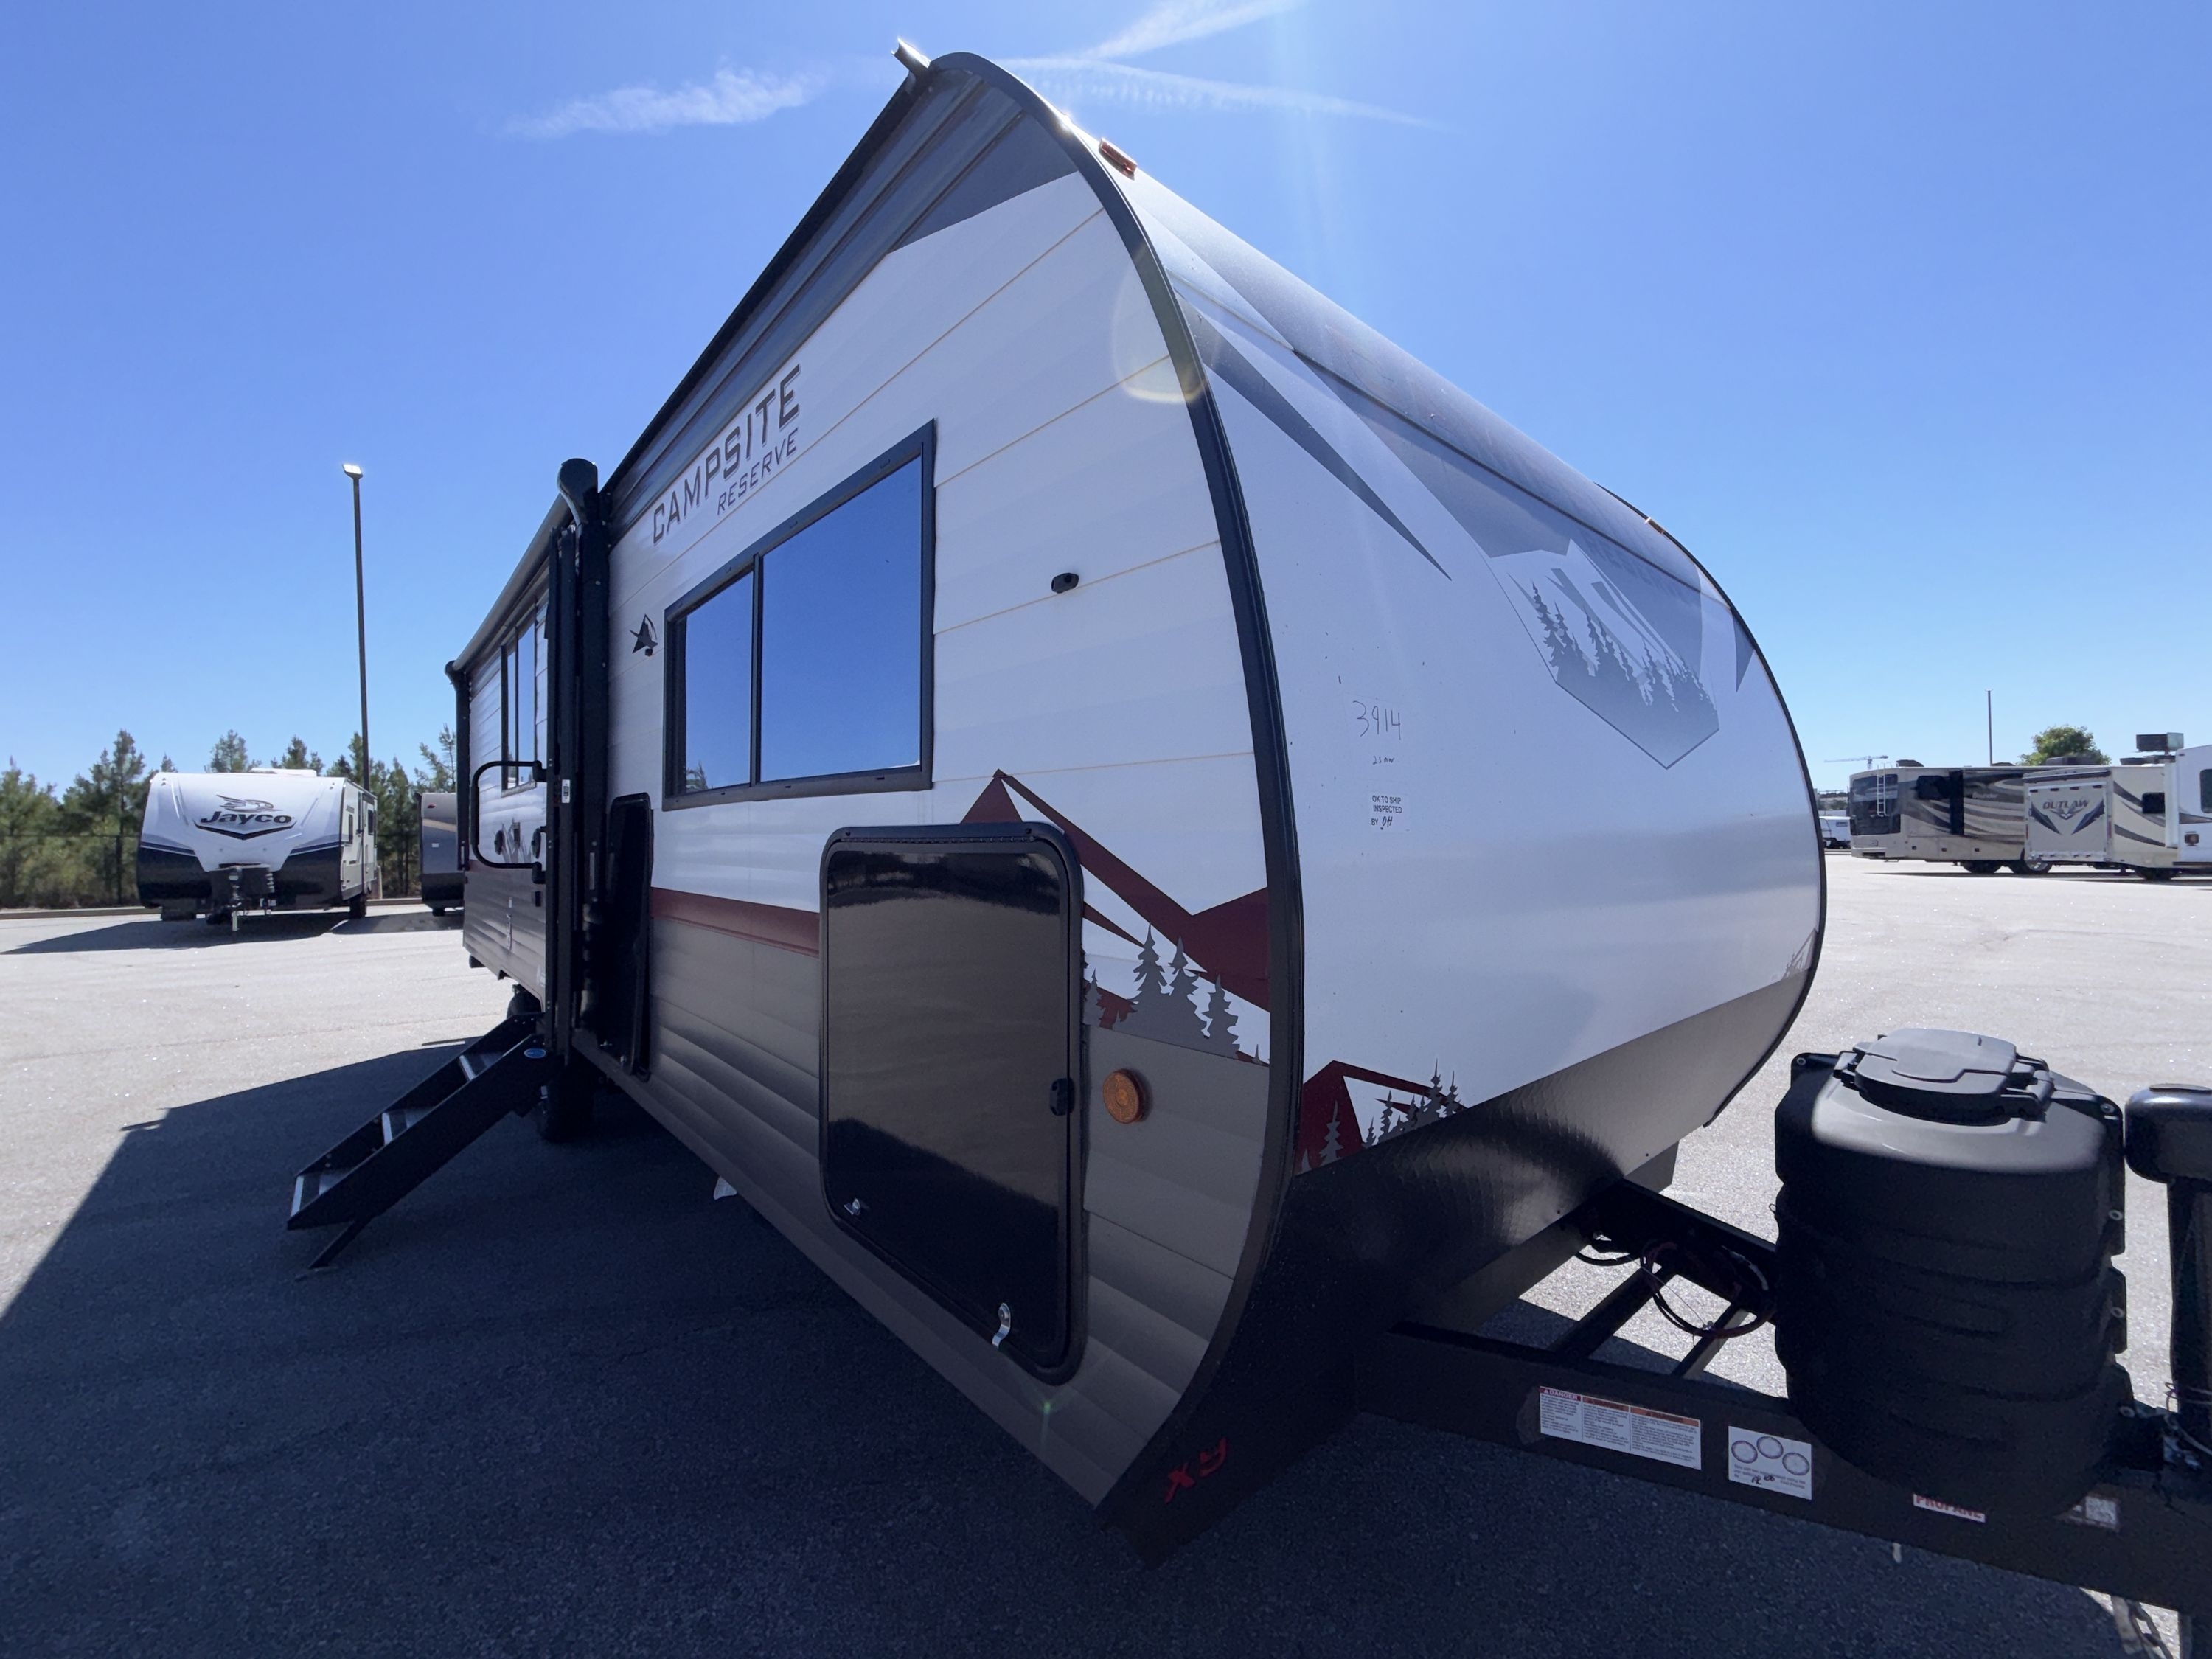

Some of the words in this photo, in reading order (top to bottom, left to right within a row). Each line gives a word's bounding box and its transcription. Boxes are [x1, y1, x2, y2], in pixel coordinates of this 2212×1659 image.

[653, 364, 800, 544] CAMPSITE
[717, 428, 799, 515] RESERVE
[1352, 700, 1401, 740] 3914
[1373, 804, 1402, 813] INSPECTED
[2042, 799, 2089, 810] OUTLAW
[201, 811, 292, 825] Jayco
[1371, 818, 1379, 826] BY
[1549, 1389, 1578, 1400] DANGER
